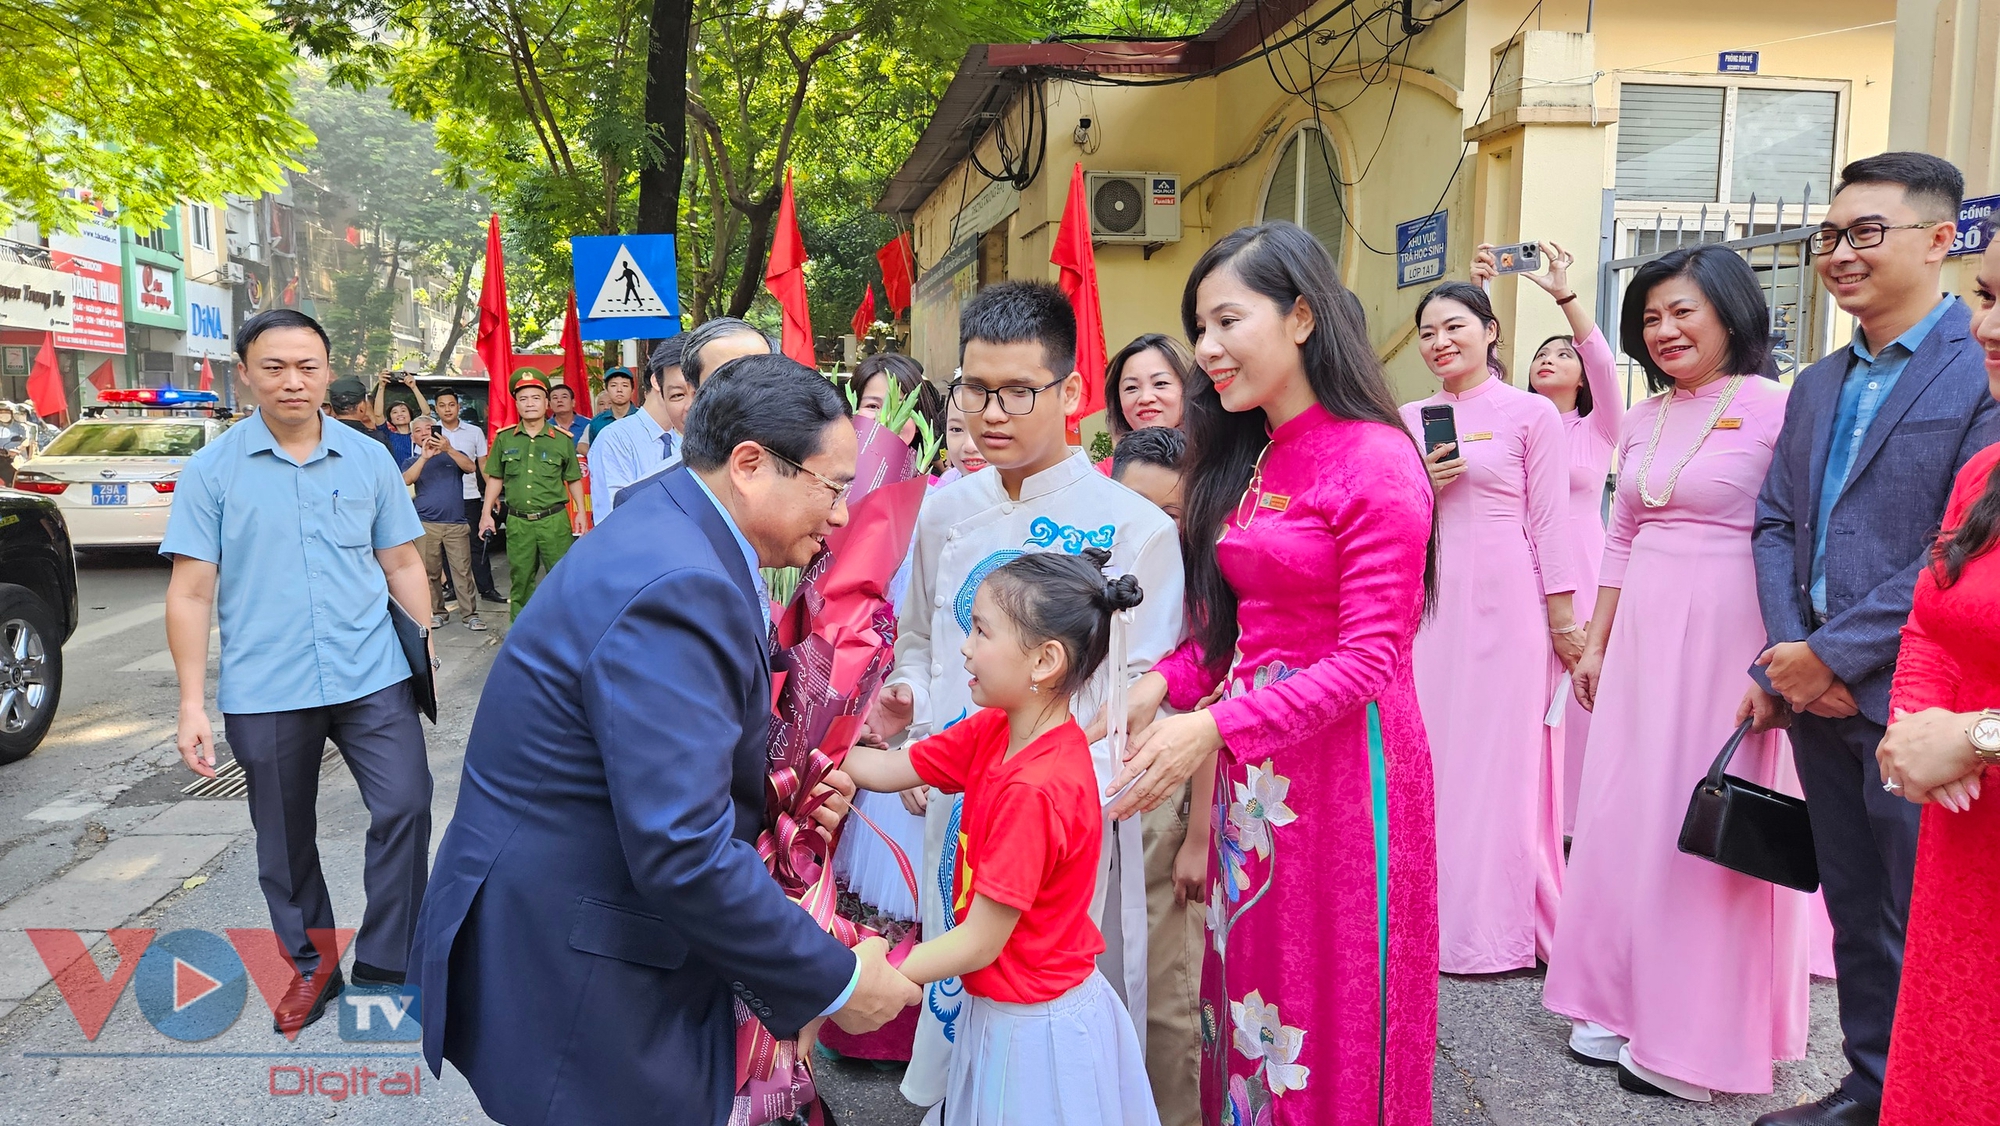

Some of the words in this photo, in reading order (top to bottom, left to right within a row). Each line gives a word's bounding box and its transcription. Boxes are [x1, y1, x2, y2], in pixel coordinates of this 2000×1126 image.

[1409, 236, 1422, 248] KHU
[1422, 231, 1436, 245] VỰC
[1949, 222, 1983, 251] SỐ
[1401, 249, 1413, 263] TRẢ
[1414, 248, 1428, 260] HỌC
[1429, 243, 1444, 256] SINH
[1409, 265, 1421, 279] LỚP
[100, 484, 120, 495] 29A
